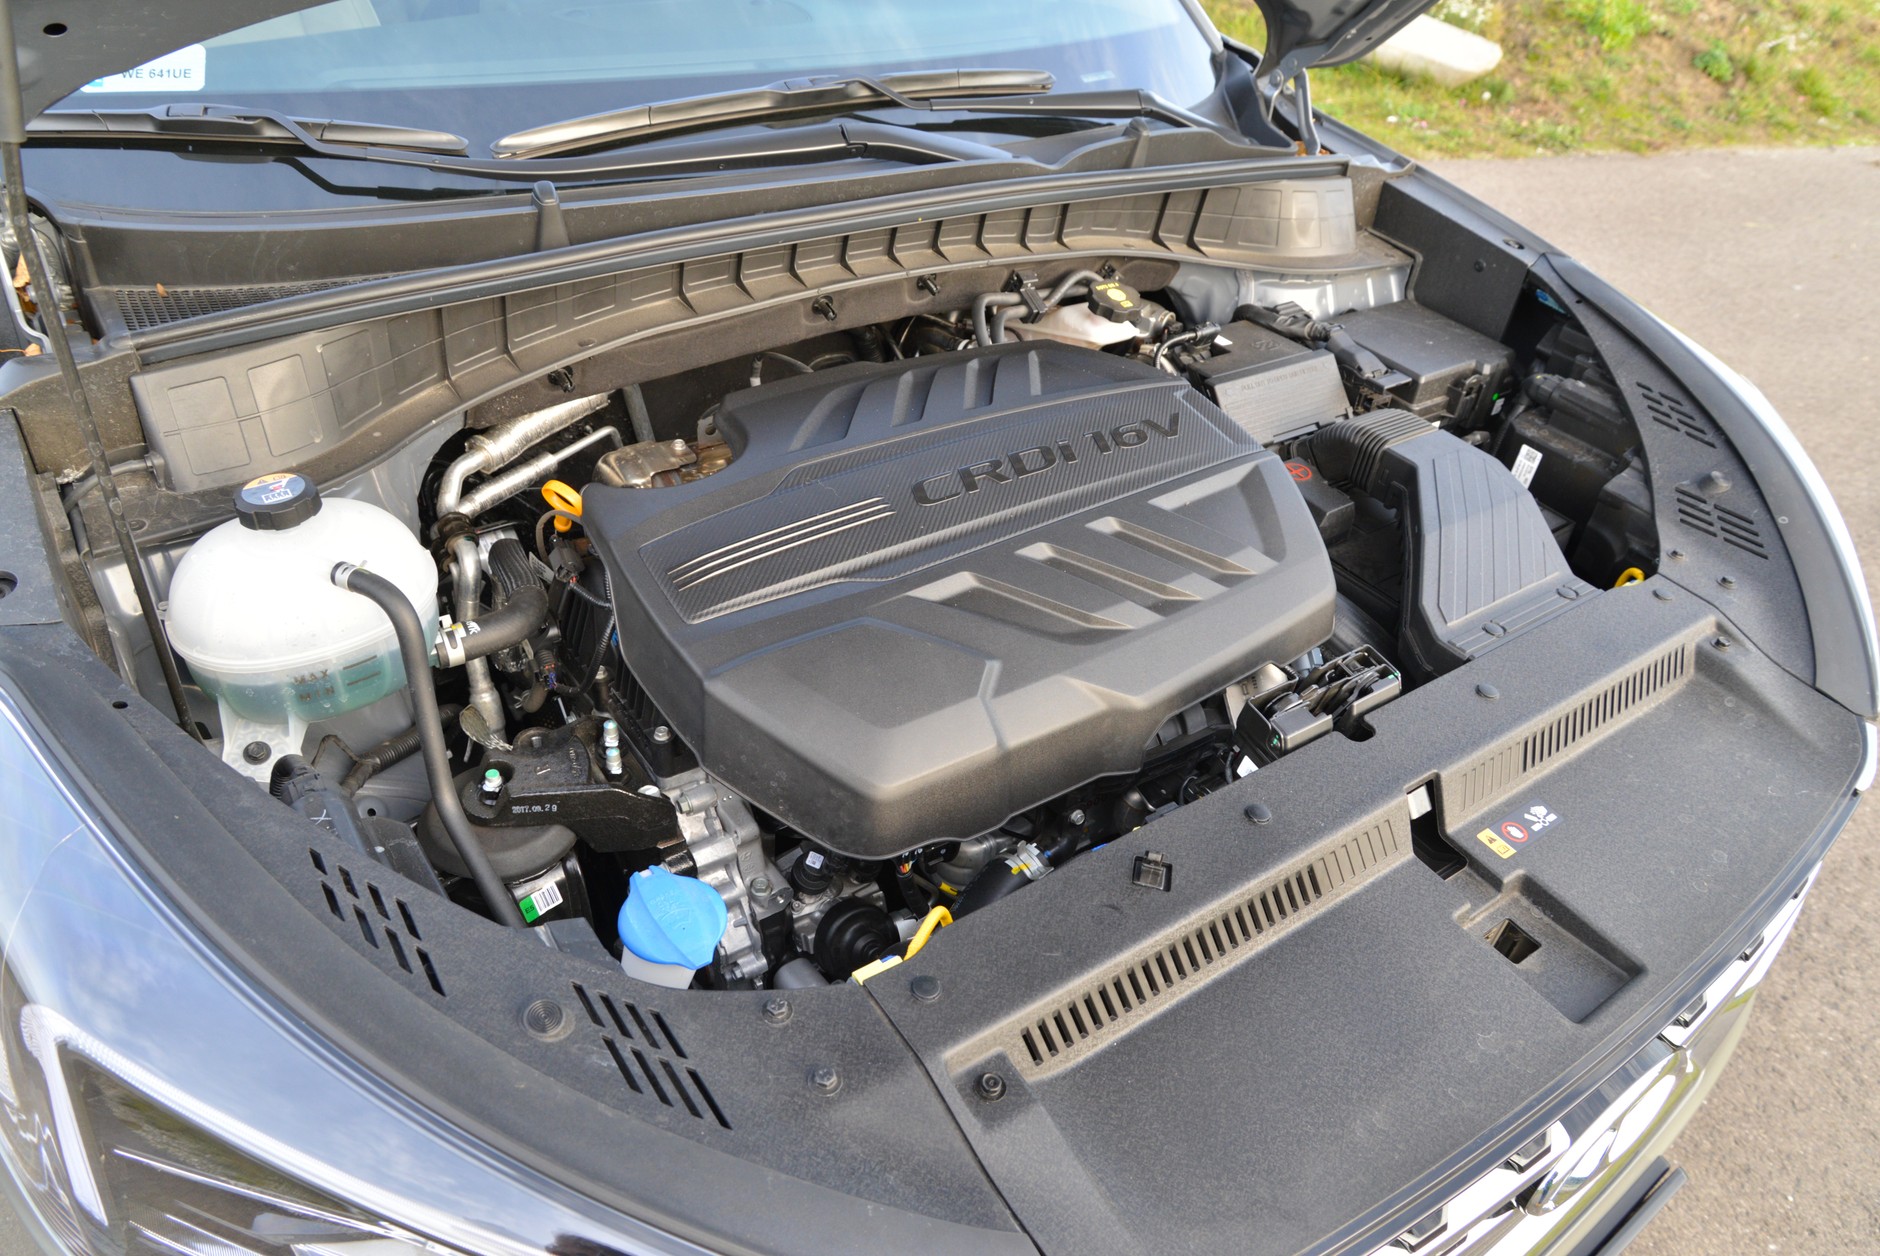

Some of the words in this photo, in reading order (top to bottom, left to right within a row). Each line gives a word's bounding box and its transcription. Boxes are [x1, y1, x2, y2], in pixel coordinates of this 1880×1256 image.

[121, 69, 144, 79] WE
[148, 68, 192, 79] 641UE
[1082, 412, 1180, 455] 16V
[293, 669, 329, 685] MAX
[298, 686, 335, 702] MIN
